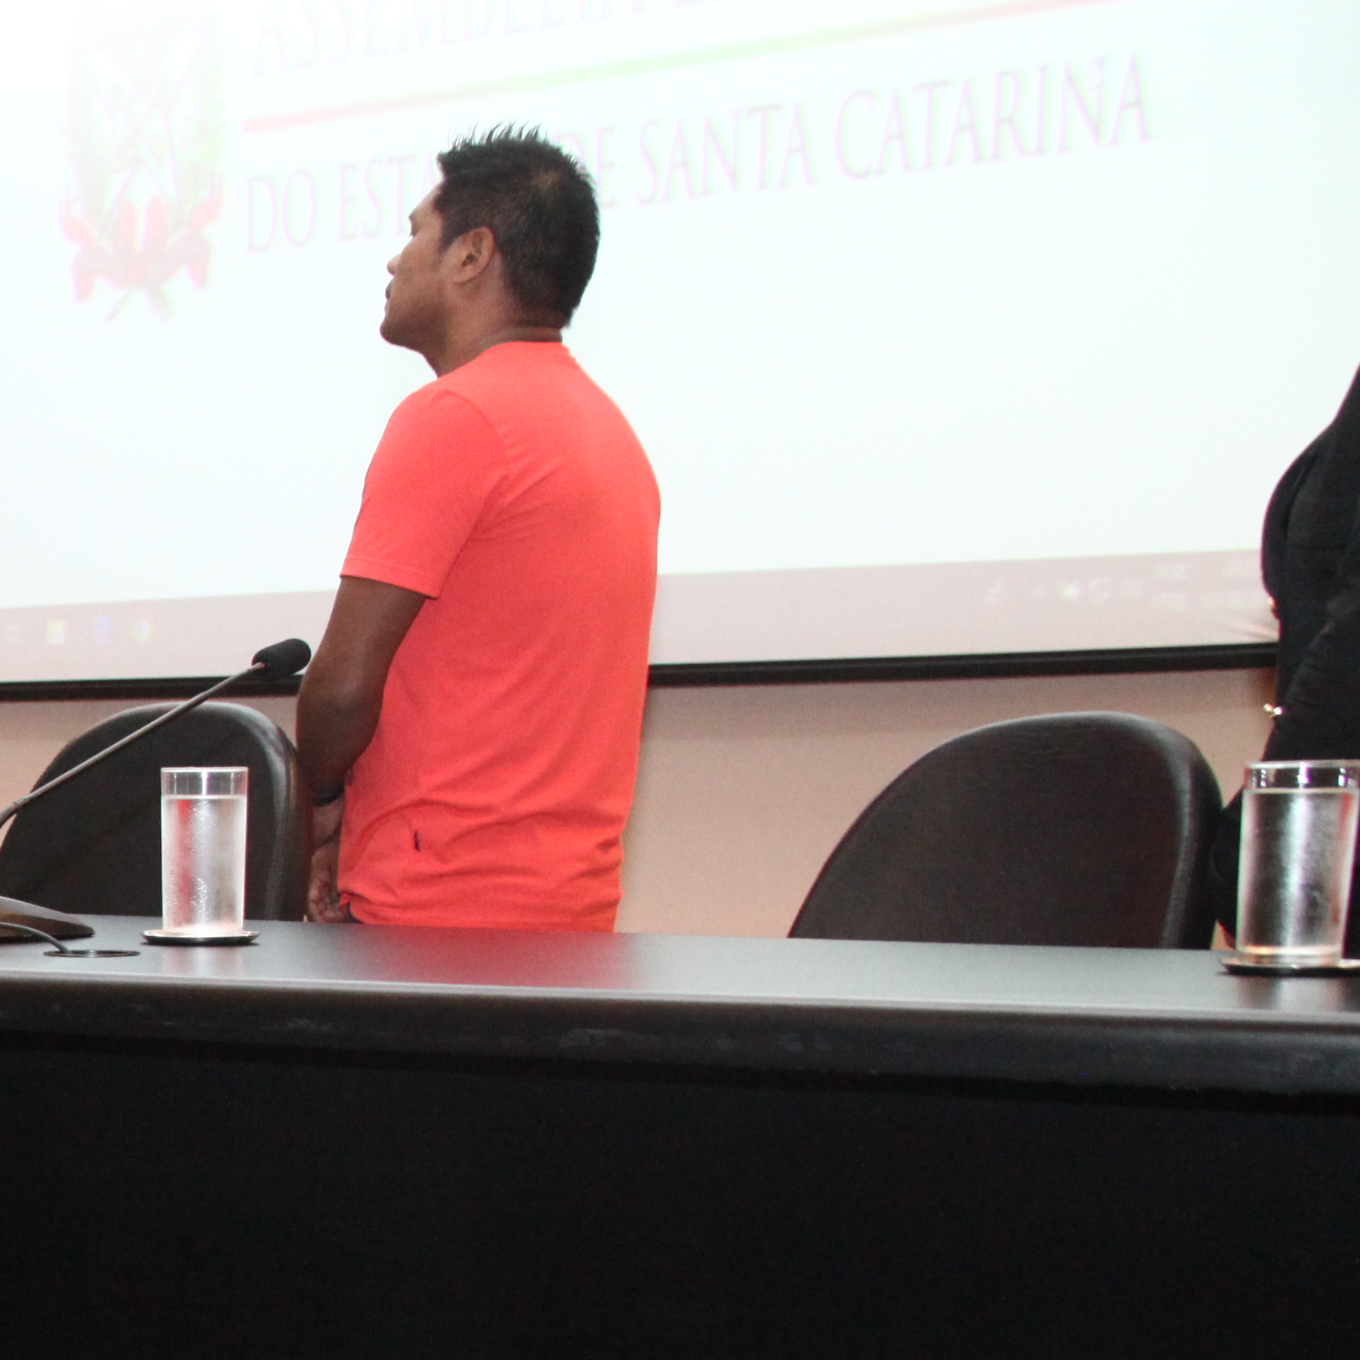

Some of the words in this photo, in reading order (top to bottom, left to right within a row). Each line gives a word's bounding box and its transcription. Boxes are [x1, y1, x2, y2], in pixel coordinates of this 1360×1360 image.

[249, 0, 643, 78] ASSEMB
[246, 168, 317, 254] DO
[338, 155, 440, 243] EST
[637, 101, 814, 206] SANTA
[832, 50, 1153, 184] CATARINA
